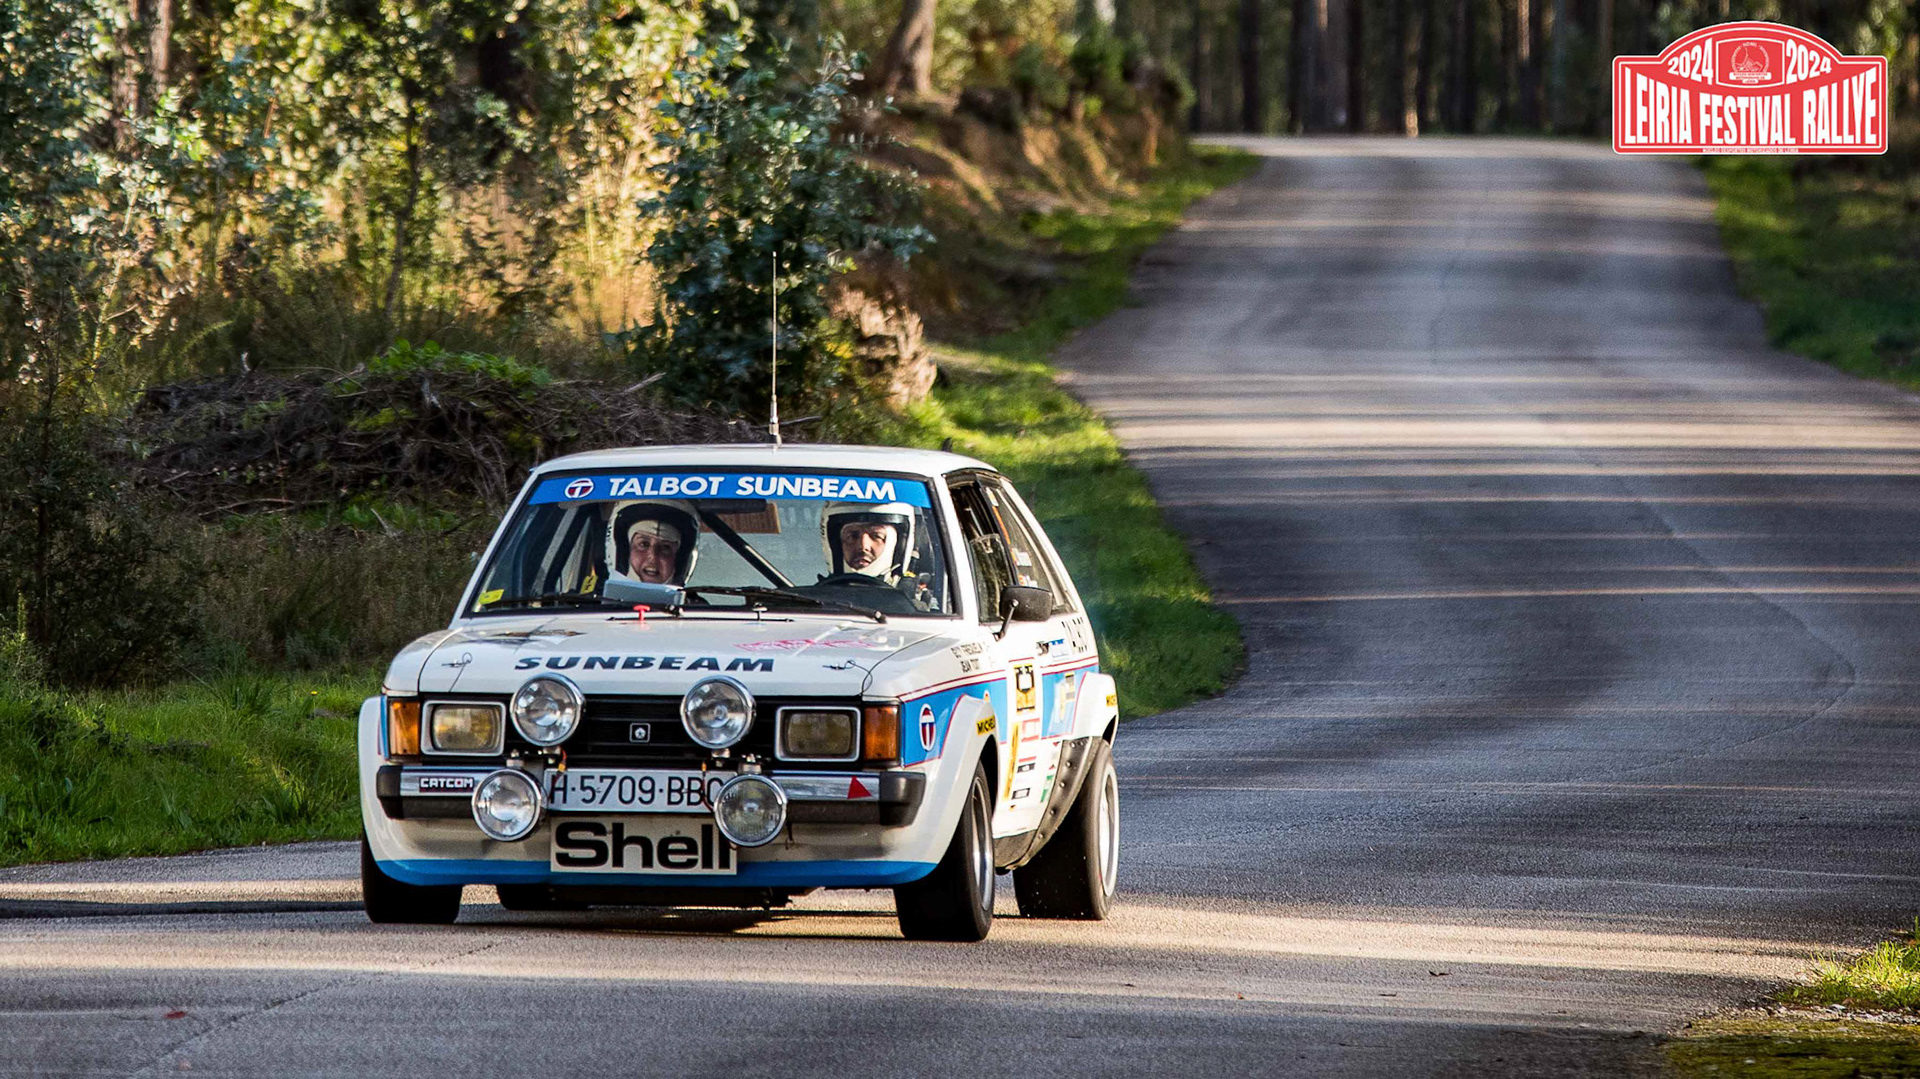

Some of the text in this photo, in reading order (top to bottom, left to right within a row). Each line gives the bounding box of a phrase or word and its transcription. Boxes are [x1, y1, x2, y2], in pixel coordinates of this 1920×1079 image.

[609, 476, 896, 501] TALBOT SUNBEAM
[514, 656, 775, 673] SUNBEAM
[420, 777, 474, 789] CATCOM
[555, 821, 731, 870] Shell
